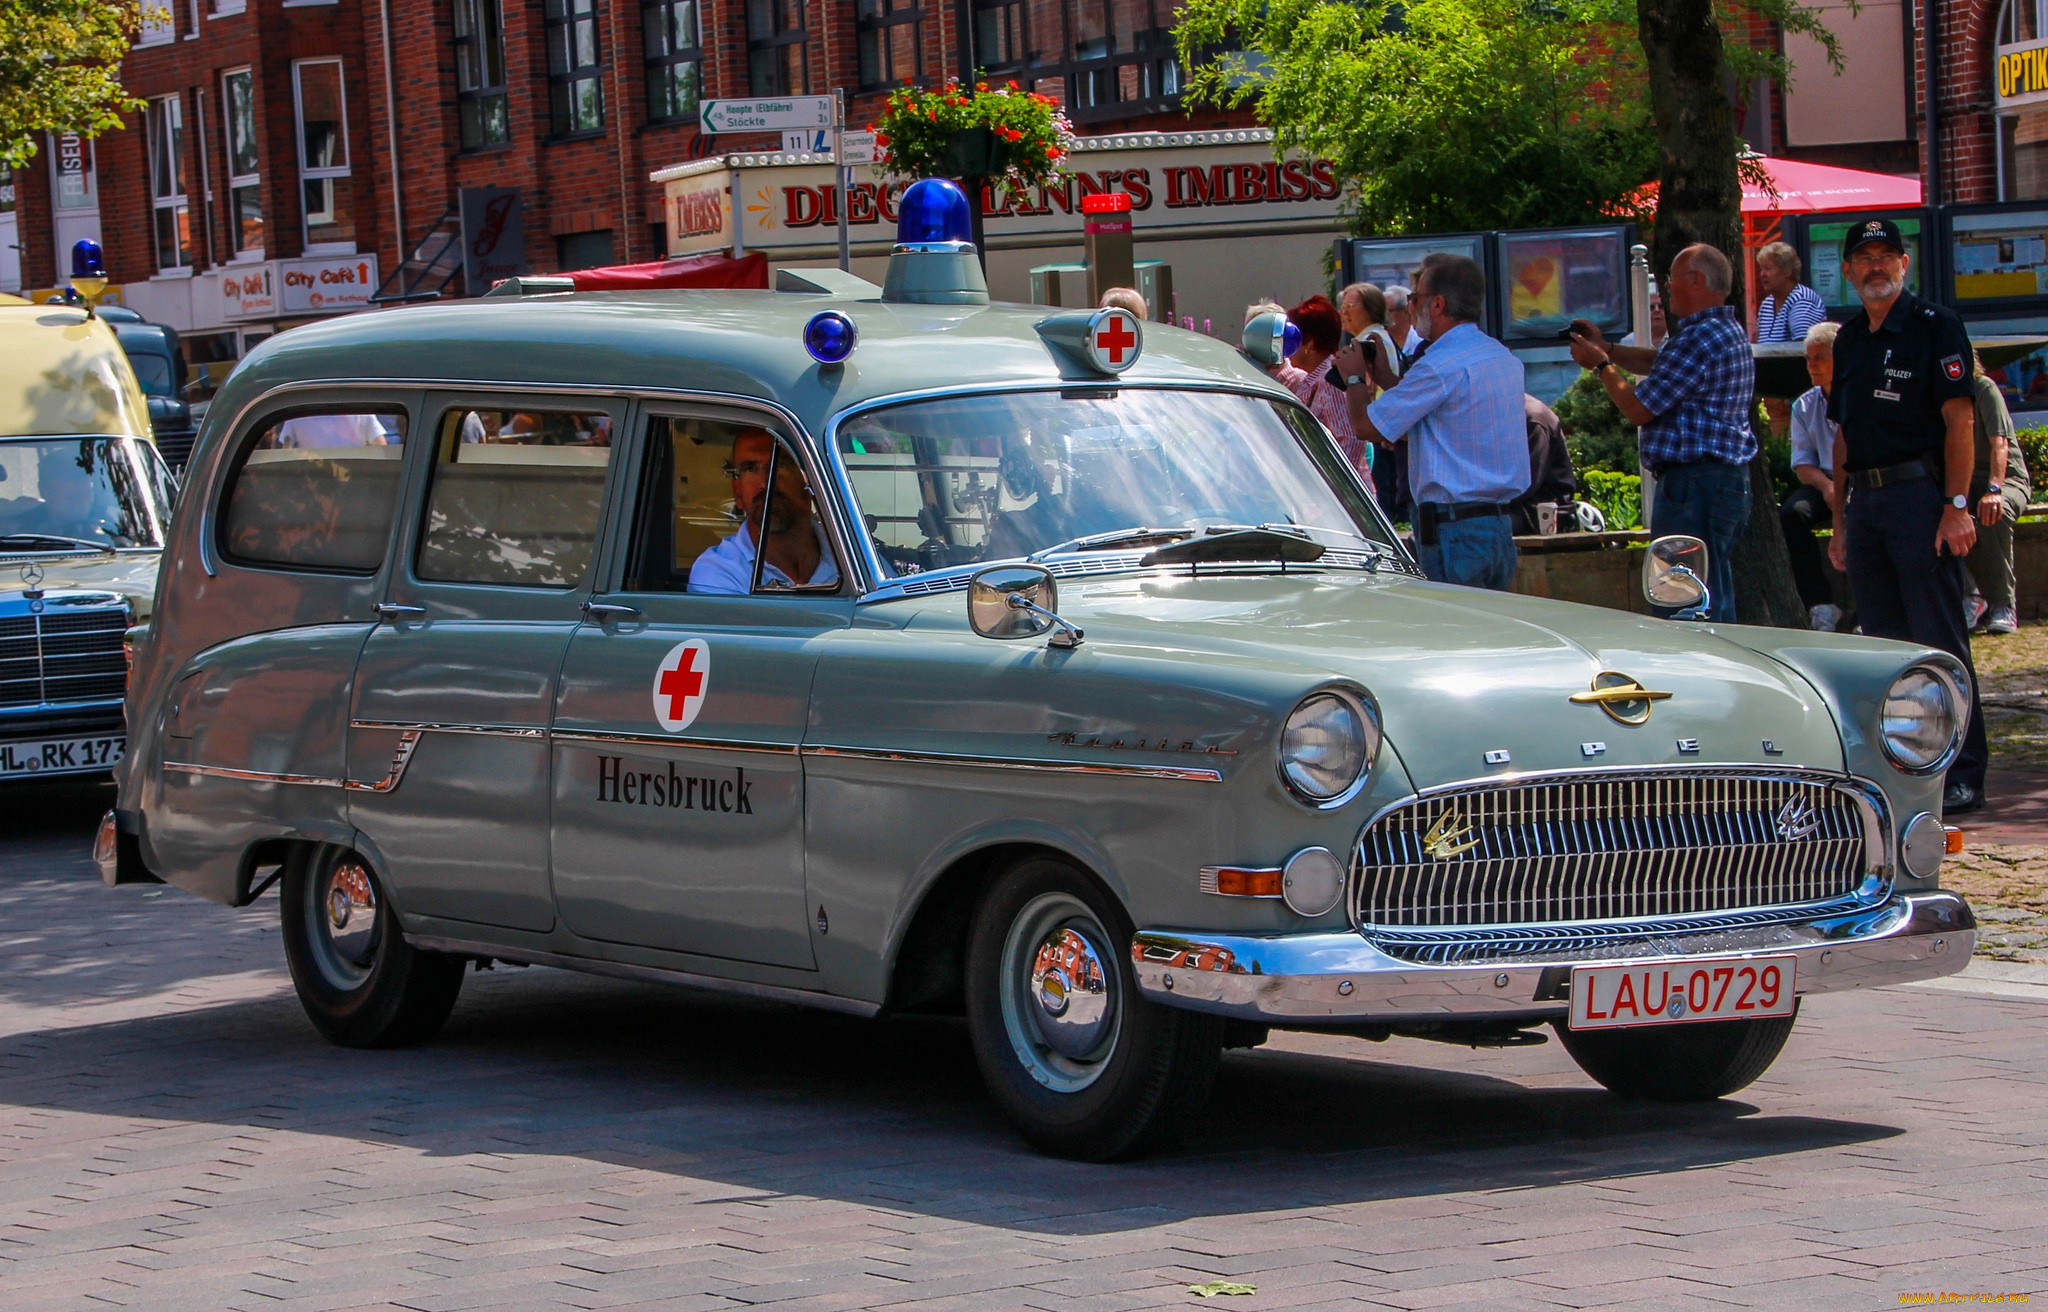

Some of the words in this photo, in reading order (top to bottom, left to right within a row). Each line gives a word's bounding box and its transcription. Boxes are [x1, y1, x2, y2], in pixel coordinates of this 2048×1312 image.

[727, 117, 766, 128] Stöckte
[790, 136, 801, 149] 11
[61, 131, 84, 195] FRISEU
[1164, 159, 1342, 210] IMBISS
[676, 188, 723, 239] IMBISS
[1862, 231, 1887, 239] POLIZEI
[285, 271, 315, 289] City
[1884, 368, 1912, 379] POLIZEI
[41, 742, 77, 768] RK
[1483, 738, 1784, 765] OPEL
[596, 755, 753, 815] Hersbruck
